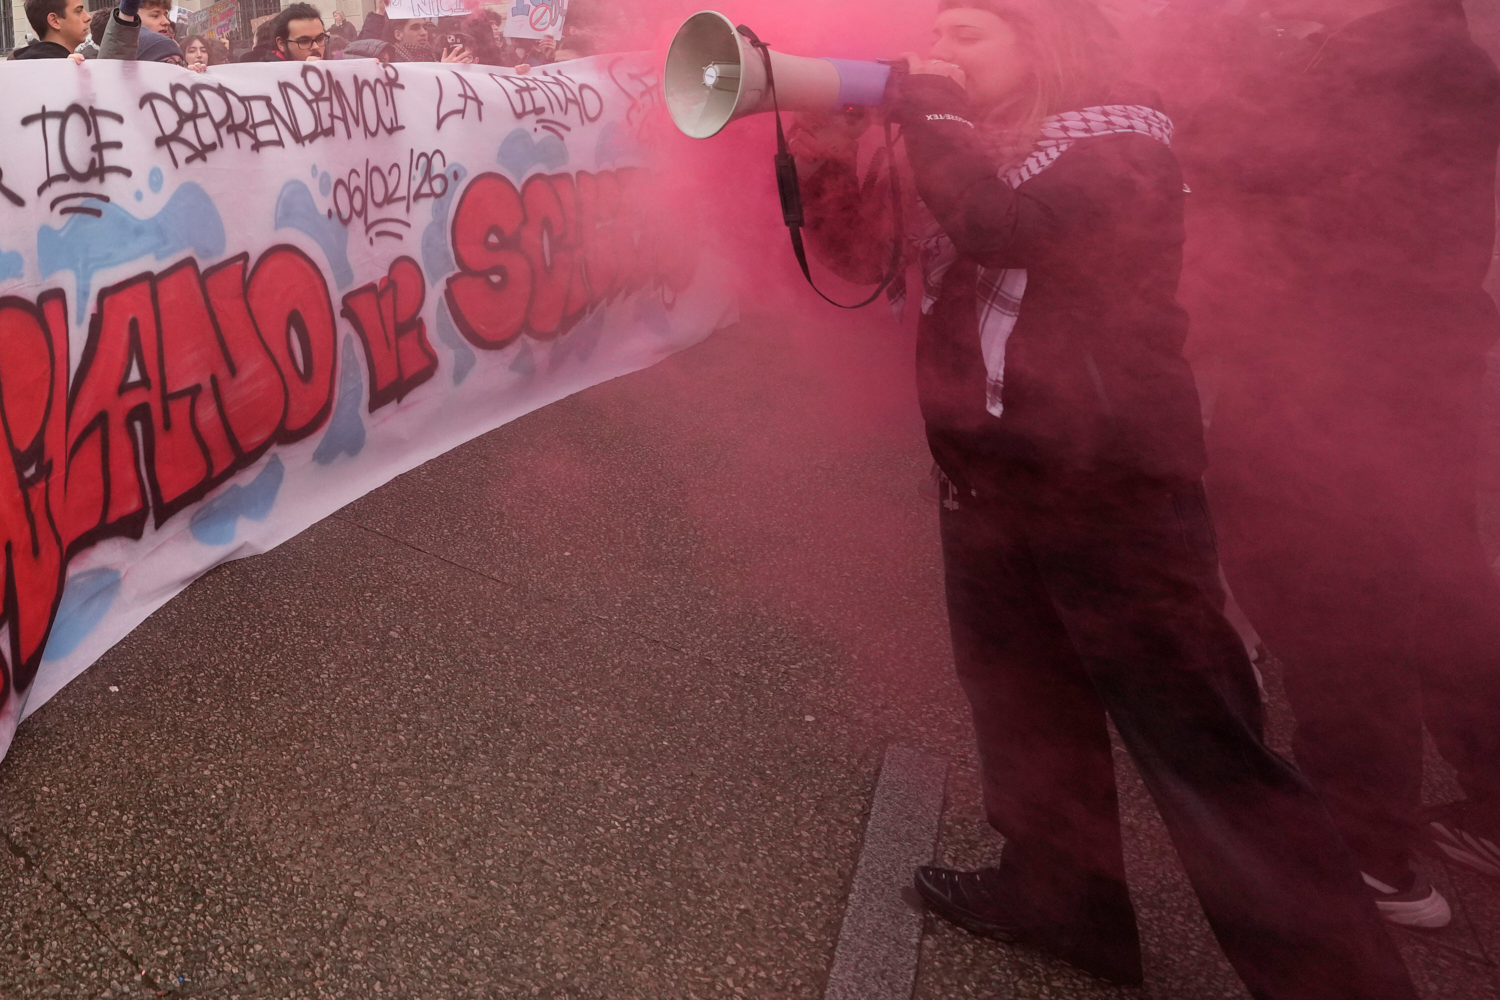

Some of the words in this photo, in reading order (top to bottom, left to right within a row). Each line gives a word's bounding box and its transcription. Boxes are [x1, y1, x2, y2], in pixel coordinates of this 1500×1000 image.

[20, 103, 132, 197] ICE
[139, 63, 405, 169] RIPRENDIAMOCI
[436, 70, 483, 132] LA
